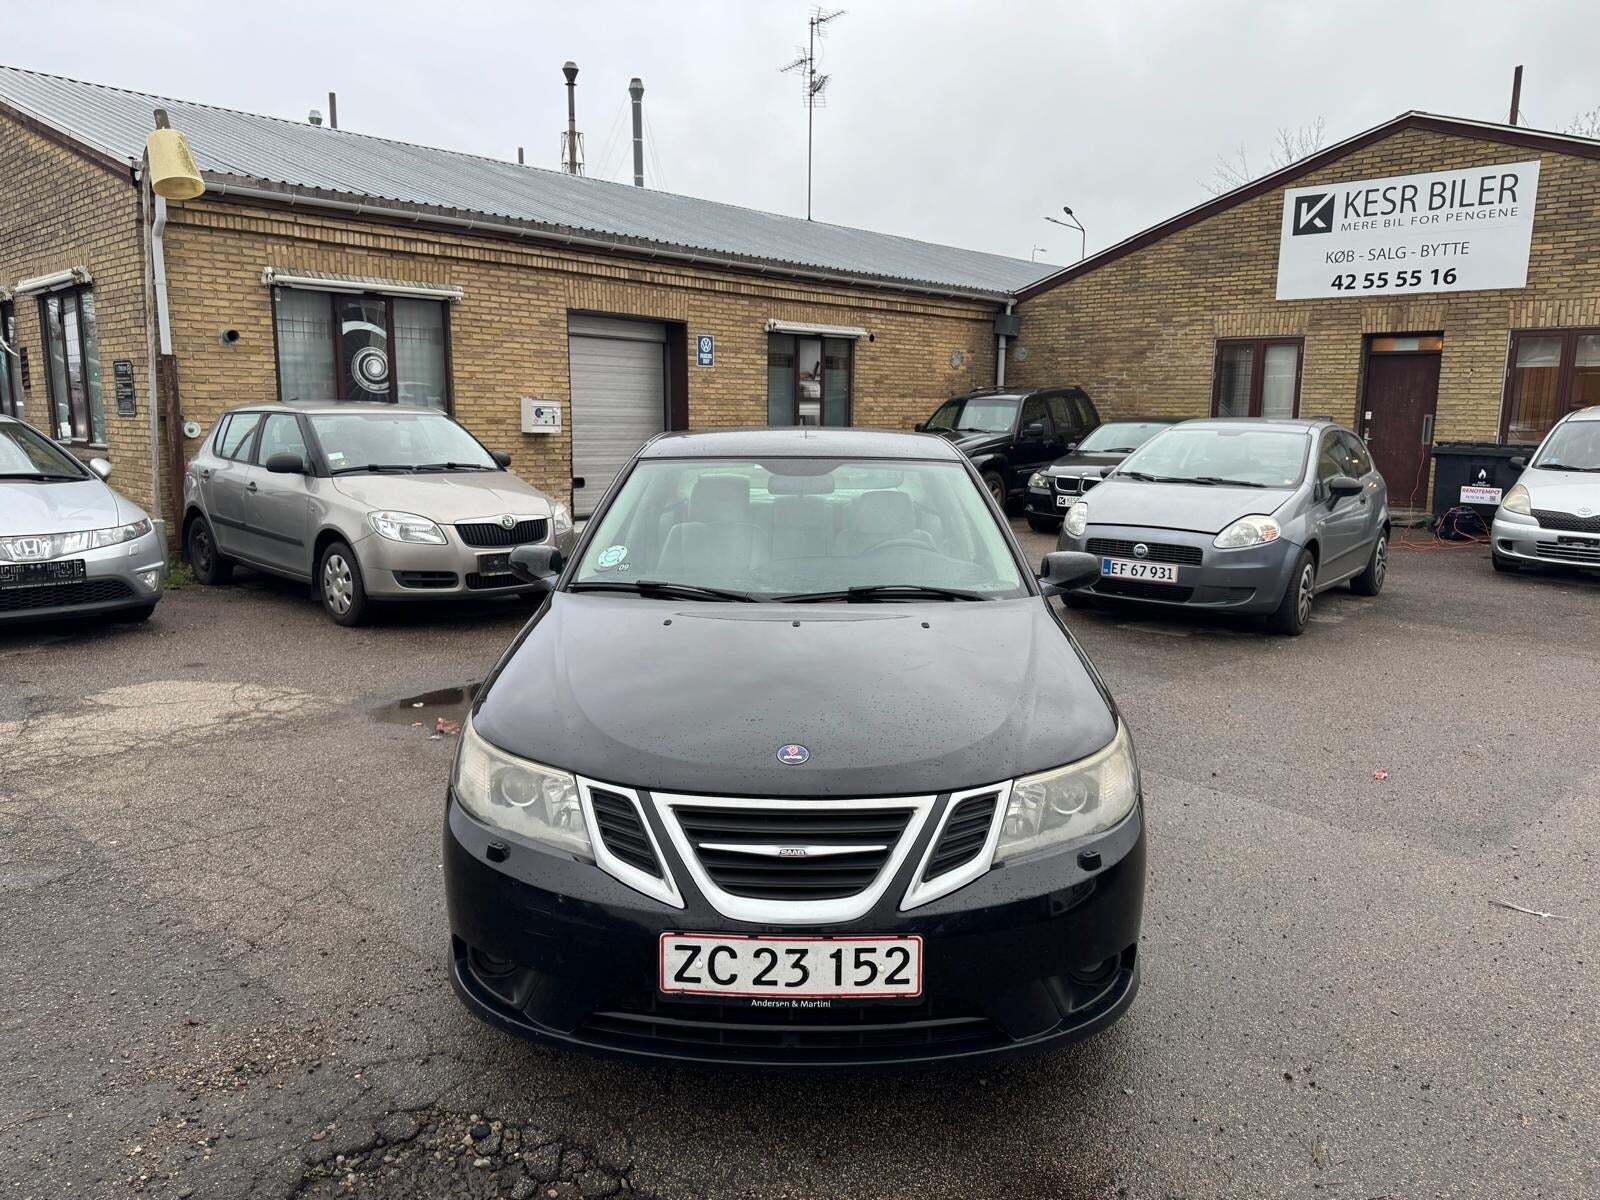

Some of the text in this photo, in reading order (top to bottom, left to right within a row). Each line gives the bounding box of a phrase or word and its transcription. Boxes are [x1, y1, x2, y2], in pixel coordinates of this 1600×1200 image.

[1343, 173, 1519, 219] KESR BILER
[1340, 207, 1519, 232] MERE BIL FOR PENGENE
[1325, 248, 1355, 264] KØB
[1367, 245, 1407, 262] SALG
[1420, 241, 1470, 258] BYTTE
[1330, 267, 1457, 291] 42 55 55 16
[1111, 562, 1173, 580] EF 67 931
[674, 945, 910, 988] ZC 23 152
